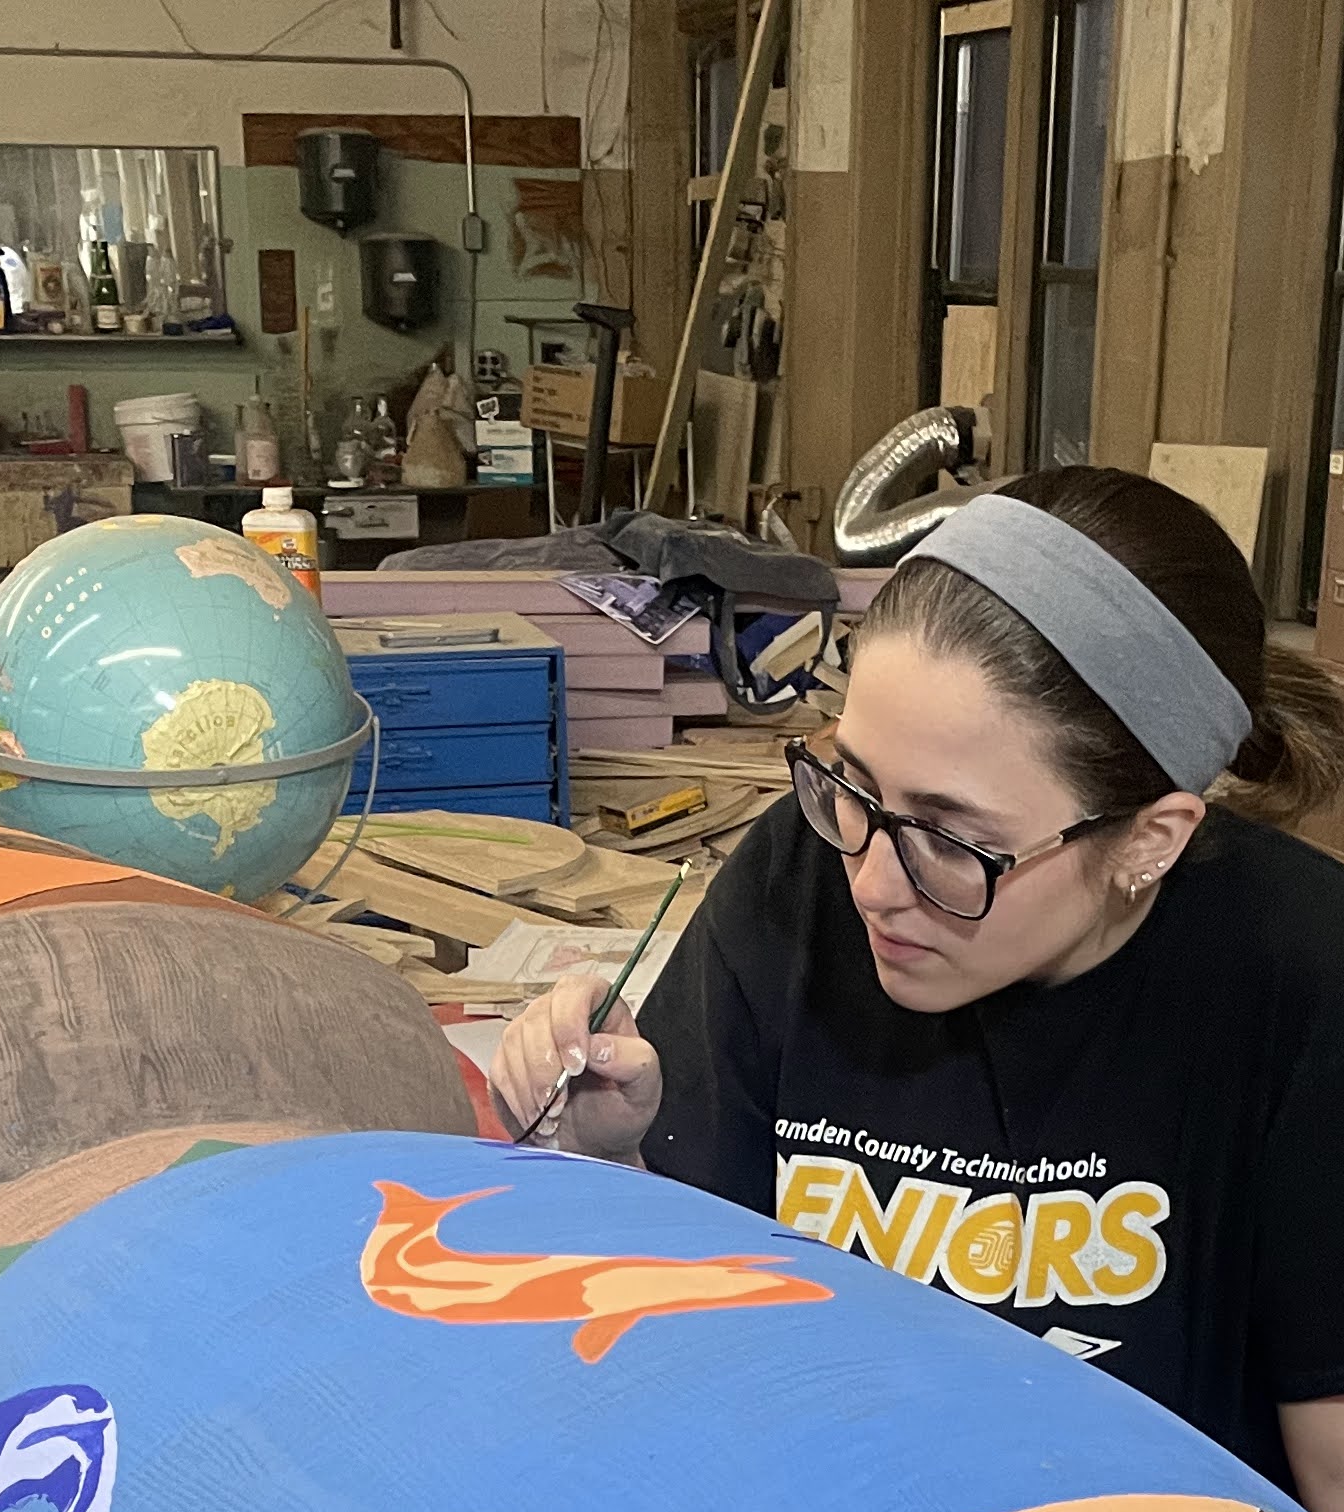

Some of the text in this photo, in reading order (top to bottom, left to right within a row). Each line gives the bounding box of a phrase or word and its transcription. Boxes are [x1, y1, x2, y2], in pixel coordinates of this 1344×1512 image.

[26, 567, 88, 623] Indian
[41, 582, 103, 639] Ocean
[775, 1117, 852, 1147] amden
[854, 1129, 938, 1173] County
[1025, 1151, 1108, 1185] chools
[776, 1150, 1171, 1309] ENIORS
